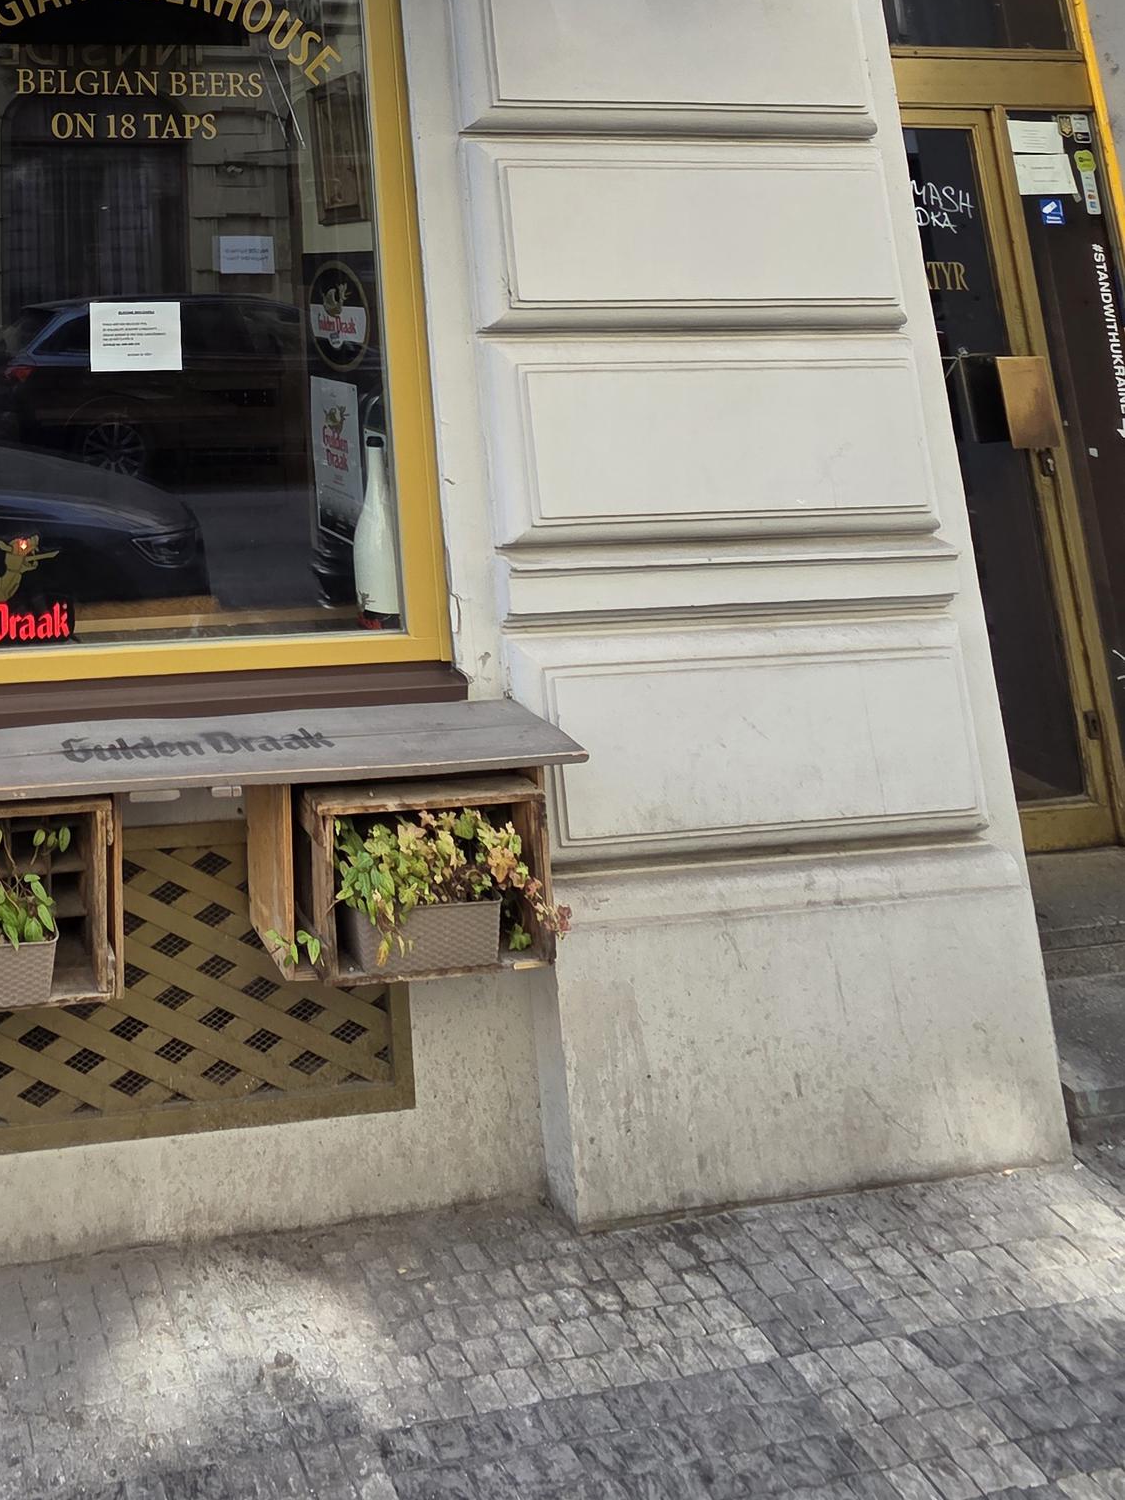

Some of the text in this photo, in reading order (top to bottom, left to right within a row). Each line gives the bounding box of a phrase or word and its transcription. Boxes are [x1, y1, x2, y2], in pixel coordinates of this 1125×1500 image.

[15, 68, 263, 99] BELGIAN BEERS
[51, 112, 218, 140] ON 18 TAPS
[926, 262, 970, 291] TYR
[60, 727, 335, 764] Gulden Draak
